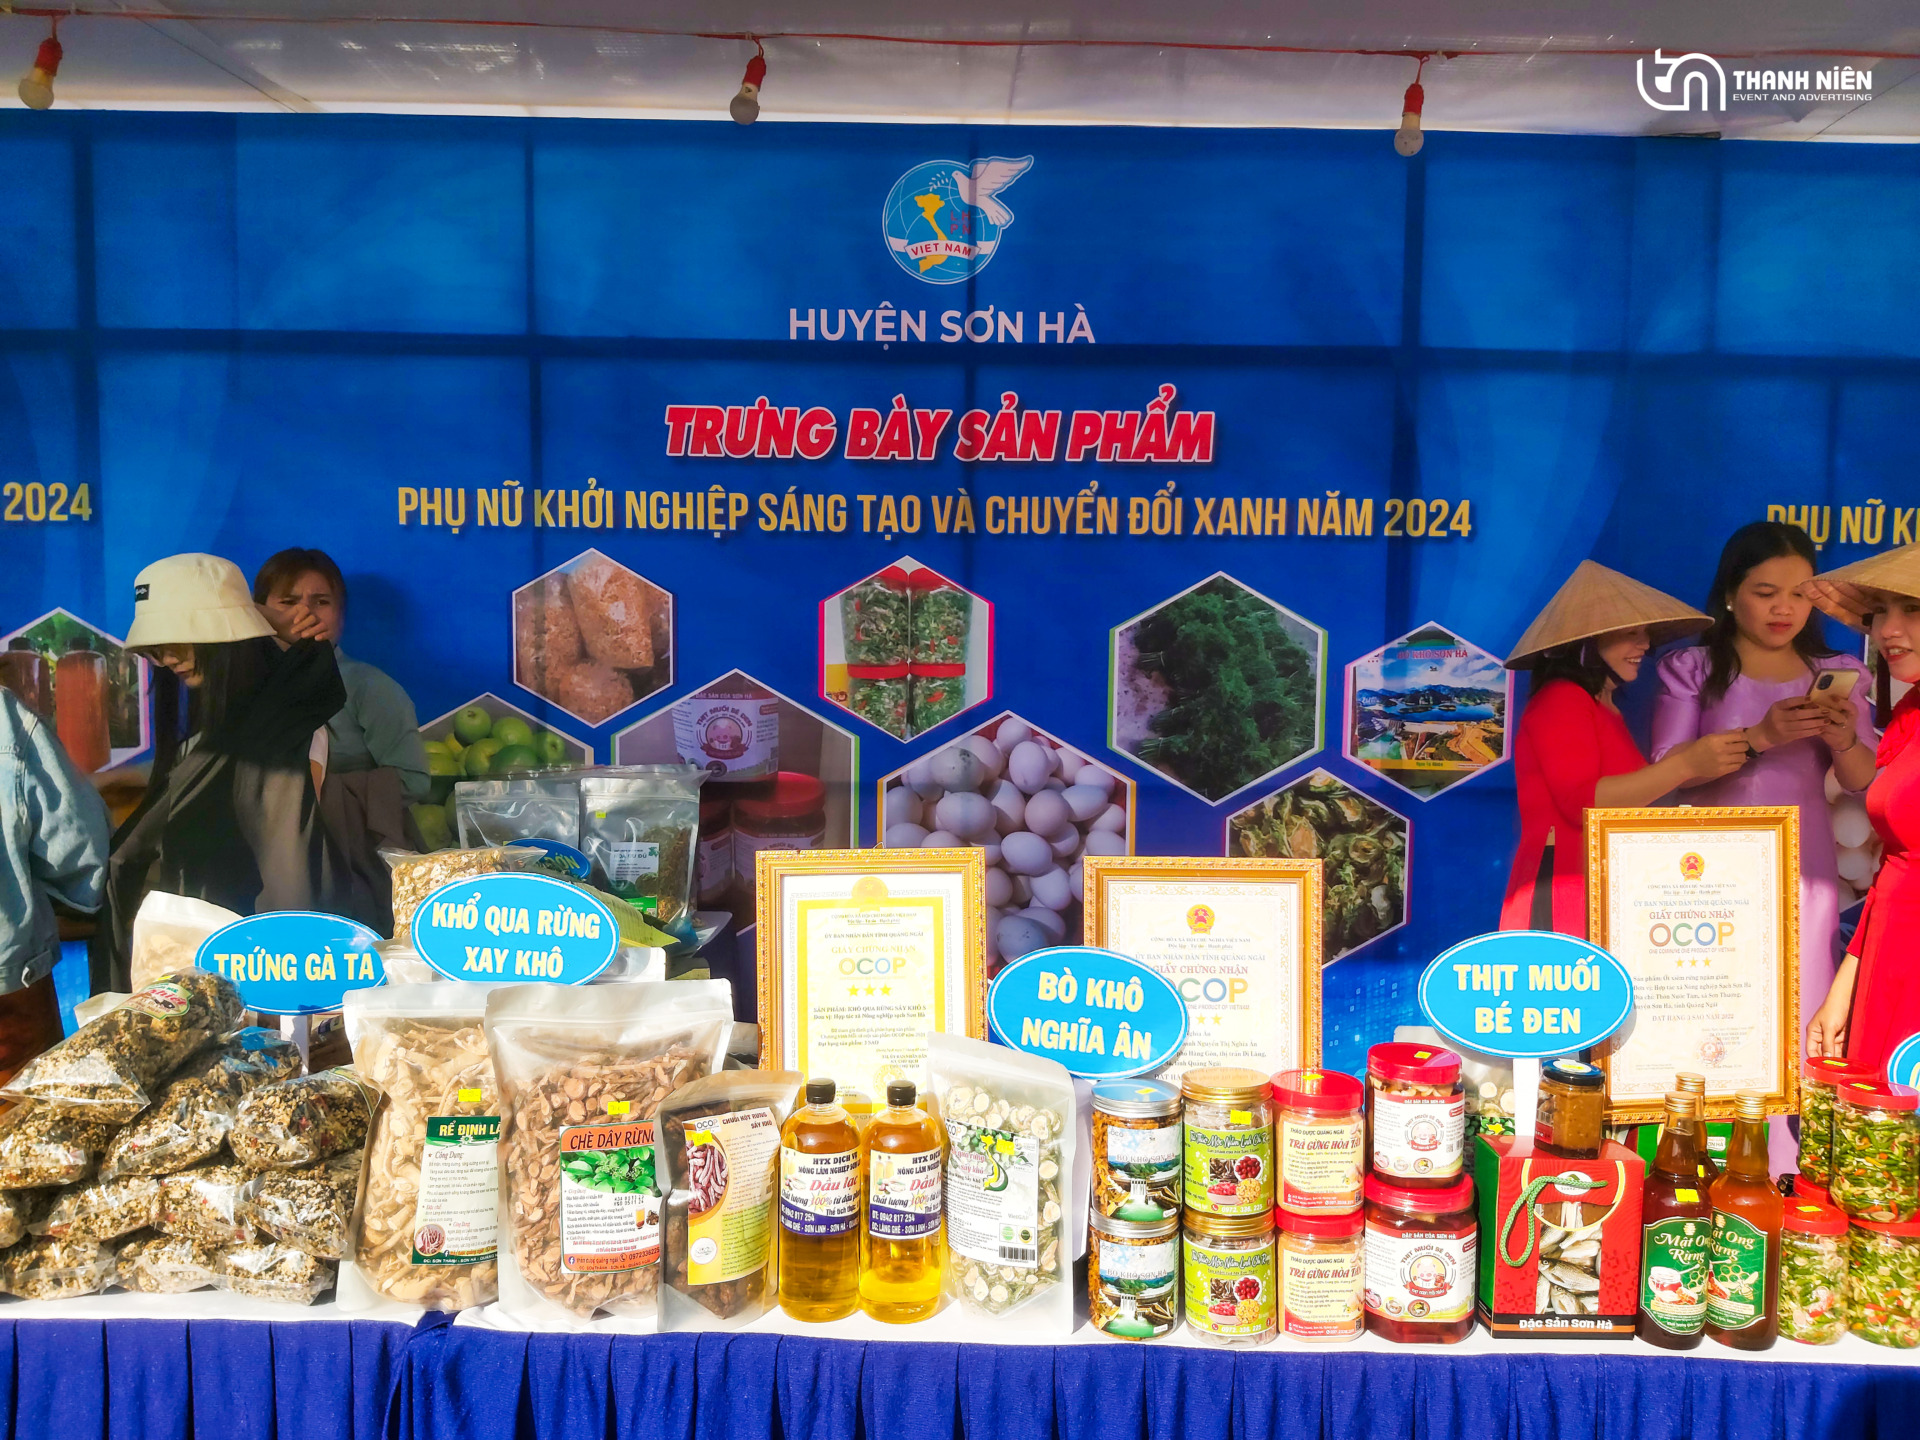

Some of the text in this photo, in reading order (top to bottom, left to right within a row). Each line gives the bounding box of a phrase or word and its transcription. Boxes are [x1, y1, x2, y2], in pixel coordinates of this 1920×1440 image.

[911, 243, 972, 257] VIET NAM
[789, 301, 1096, 351] HUYỆN SƠN HÀ
[665, 383, 1215, 463] TRƯNG BÀY SẢN PHẨM
[3, 482, 92, 521] 2024
[398, 477, 1472, 541] PHỤ NỮ KHỞI NGHIỆP SÁNG TẠO VÀ CHUYỂN ĐỔI XANH NĂM 2024
[1840, 498, 1886, 544] NỮ
[1455, 649, 1468, 658] HÀ
[432, 892, 600, 939] KHỔ QUA RỪNG
[1650, 908, 1735, 920] GIẤY CHỨNG NHẬN
[1649, 922, 1735, 947] OCOP
[214, 945, 375, 982] TRỨNG GÀ TA
[463, 946, 564, 978] XAY KHÔ
[839, 957, 906, 975] OCOP
[1152, 961, 1248, 976] GIẤY CHỨNG NHẬN
[1453, 954, 1600, 997] THỊT MUỐI
[1038, 967, 1144, 1013] BÒ KHÔ
[1167, 977, 1249, 1003] COP
[1475, 1000, 1581, 1034] BÉ ĐEN
[1021, 1016, 1152, 1061] NGHĨA ÂN
[696, 1119, 718, 1129] OCOP
[570, 1131, 594, 1150] CHÈ
[597, 1130, 622, 1148] DÂY
[1289, 1138, 1305, 1150] TRÀ
[1307, 1138, 1330, 1150] GỪNG
[1331, 1138, 1350, 1150] HÒA
[833, 1155, 851, 1166] DỊCH
[912, 1155, 928, 1164] HTX
[810, 1176, 858, 1191] Dầu lạc
[910, 1175, 936, 1191] Dầu
[790, 1194, 808, 1206] lượng
[811, 1196, 833, 1206] 100%
[872, 1194, 887, 1205] Chất
[888, 1197, 909, 1208] lượng
[880, 1212, 892, 1222] 0942
[894, 1213, 903, 1223] 817
[905, 1214, 915, 1222] 254
[1654, 1232, 1694, 1248] Mật
[1726, 1231, 1755, 1250] Ong
[1669, 1248, 1706, 1265] Rừng
[1289, 1266, 1306, 1278] TRÀ
[1307, 1267, 1330, 1279] GỪNG
[1331, 1266, 1350, 1278] HÒA
[1519, 1317, 1613, 1330] Đặc Sản Sơn Hà
